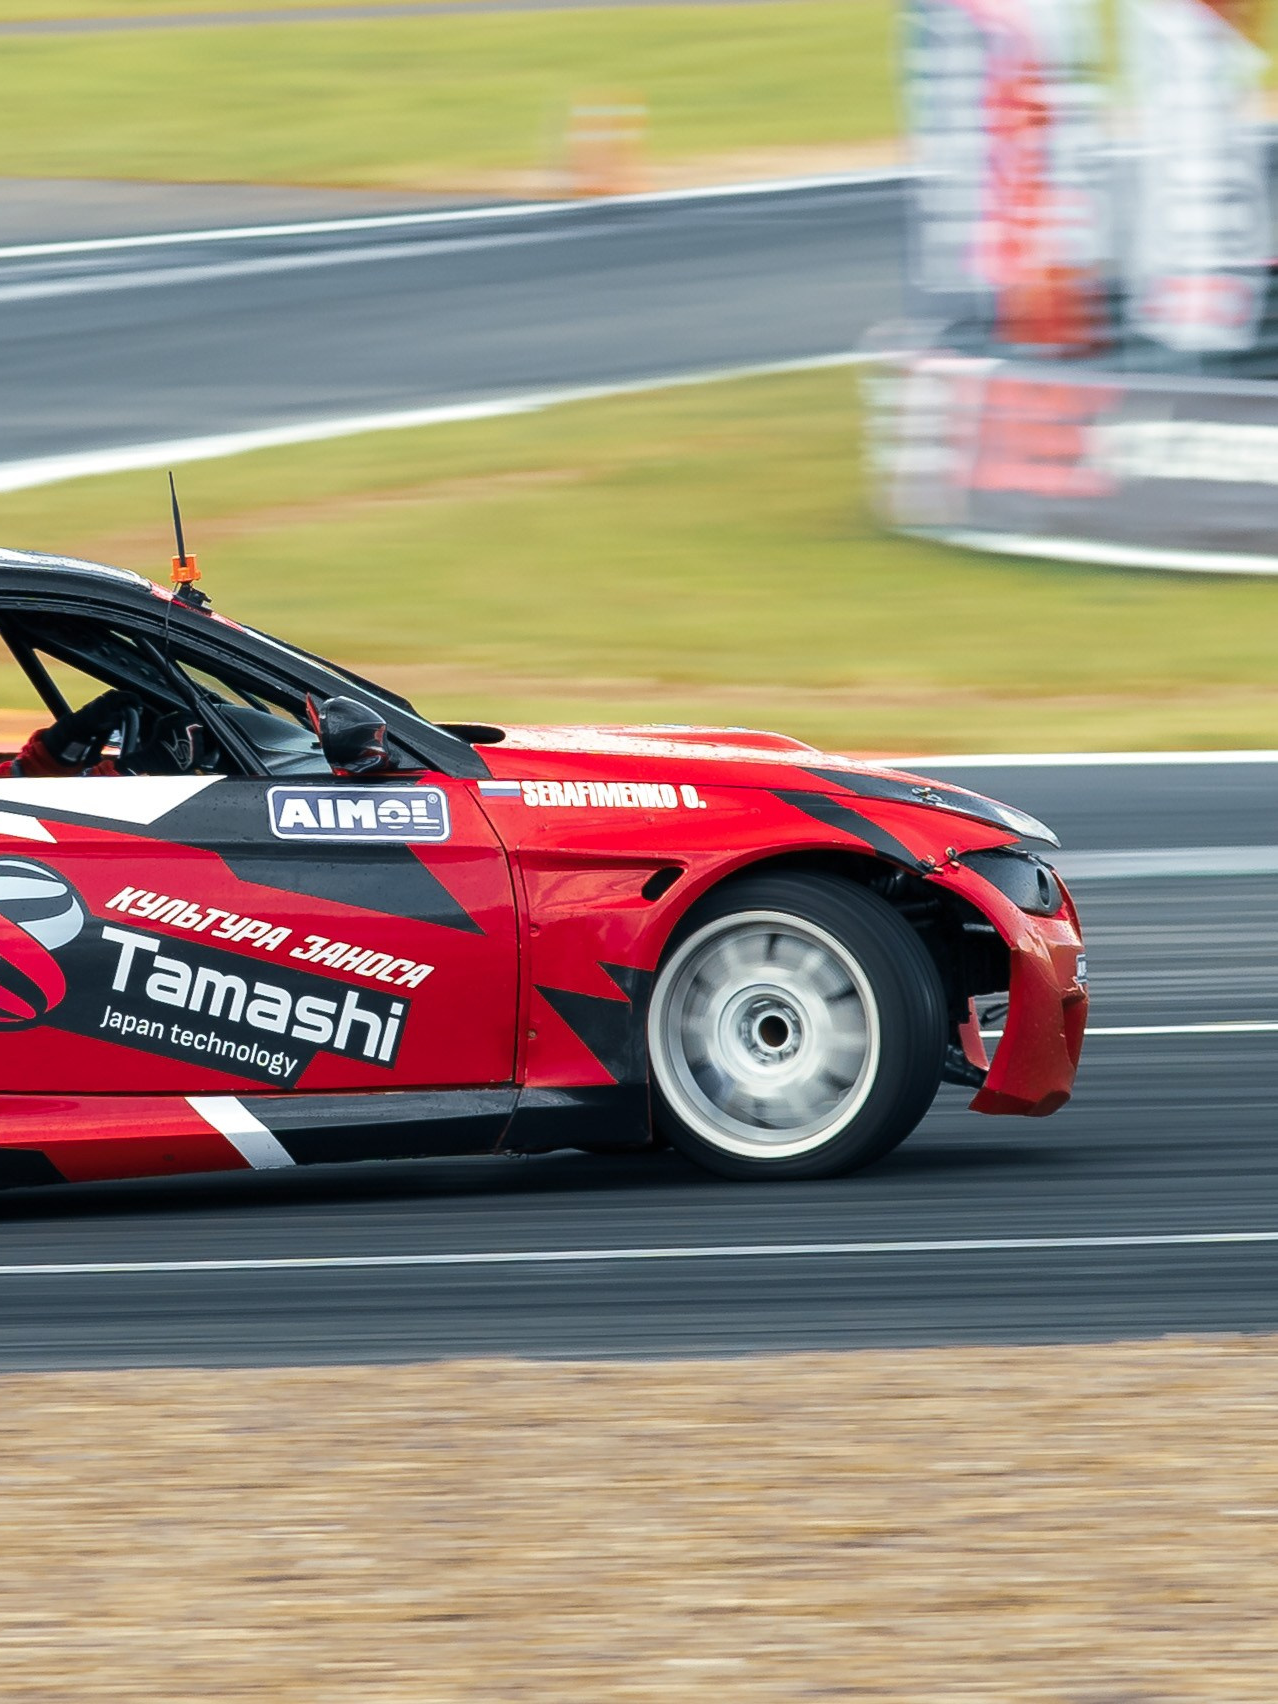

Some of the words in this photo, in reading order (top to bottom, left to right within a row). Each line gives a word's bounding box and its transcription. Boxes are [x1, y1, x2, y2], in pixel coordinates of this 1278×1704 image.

[278, 798, 441, 830] AIMOL
[522, 781, 677, 809] SERAFIMENKO
[105, 886, 292, 951] КУЛЬТУРА
[289, 935, 435, 988] ЗАНОСА
[102, 926, 404, 1062] Tamashi
[100, 1005, 164, 1040] Japan
[170, 1023, 298, 1077] technology
